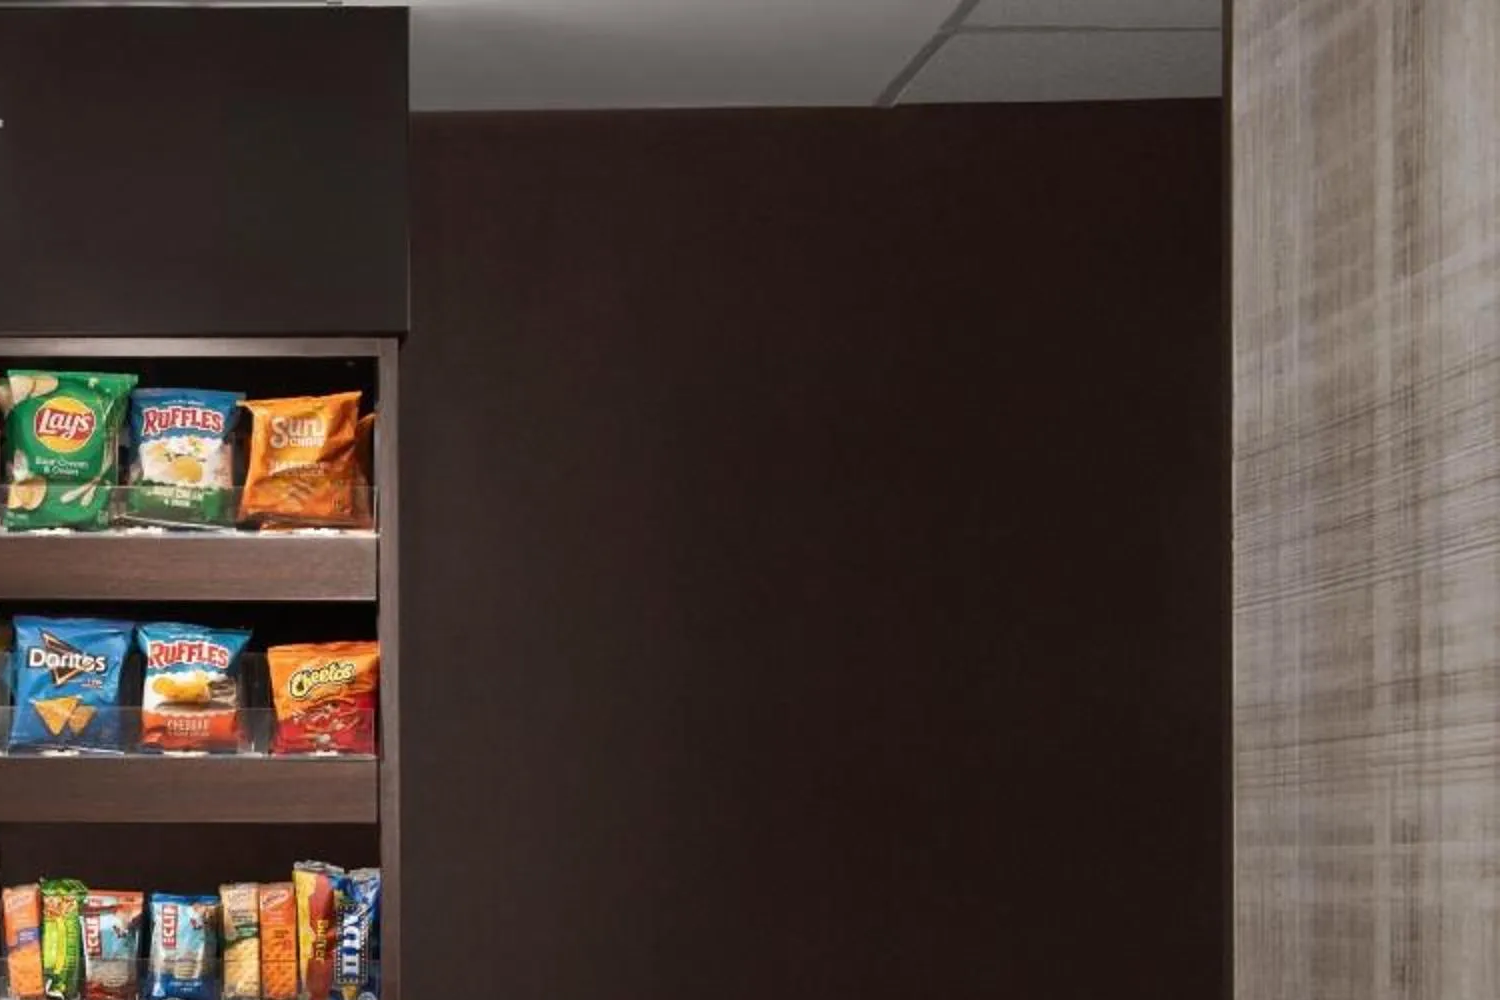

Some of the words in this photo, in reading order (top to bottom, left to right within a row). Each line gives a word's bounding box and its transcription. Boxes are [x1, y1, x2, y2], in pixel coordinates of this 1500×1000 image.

[38, 408, 92, 439] Lay's
[143, 407, 225, 435] RUFFLES
[29, 648, 106, 671] Doritos
[148, 640, 229, 669] RUFFLES
[289, 662, 356, 698] Cheetos
